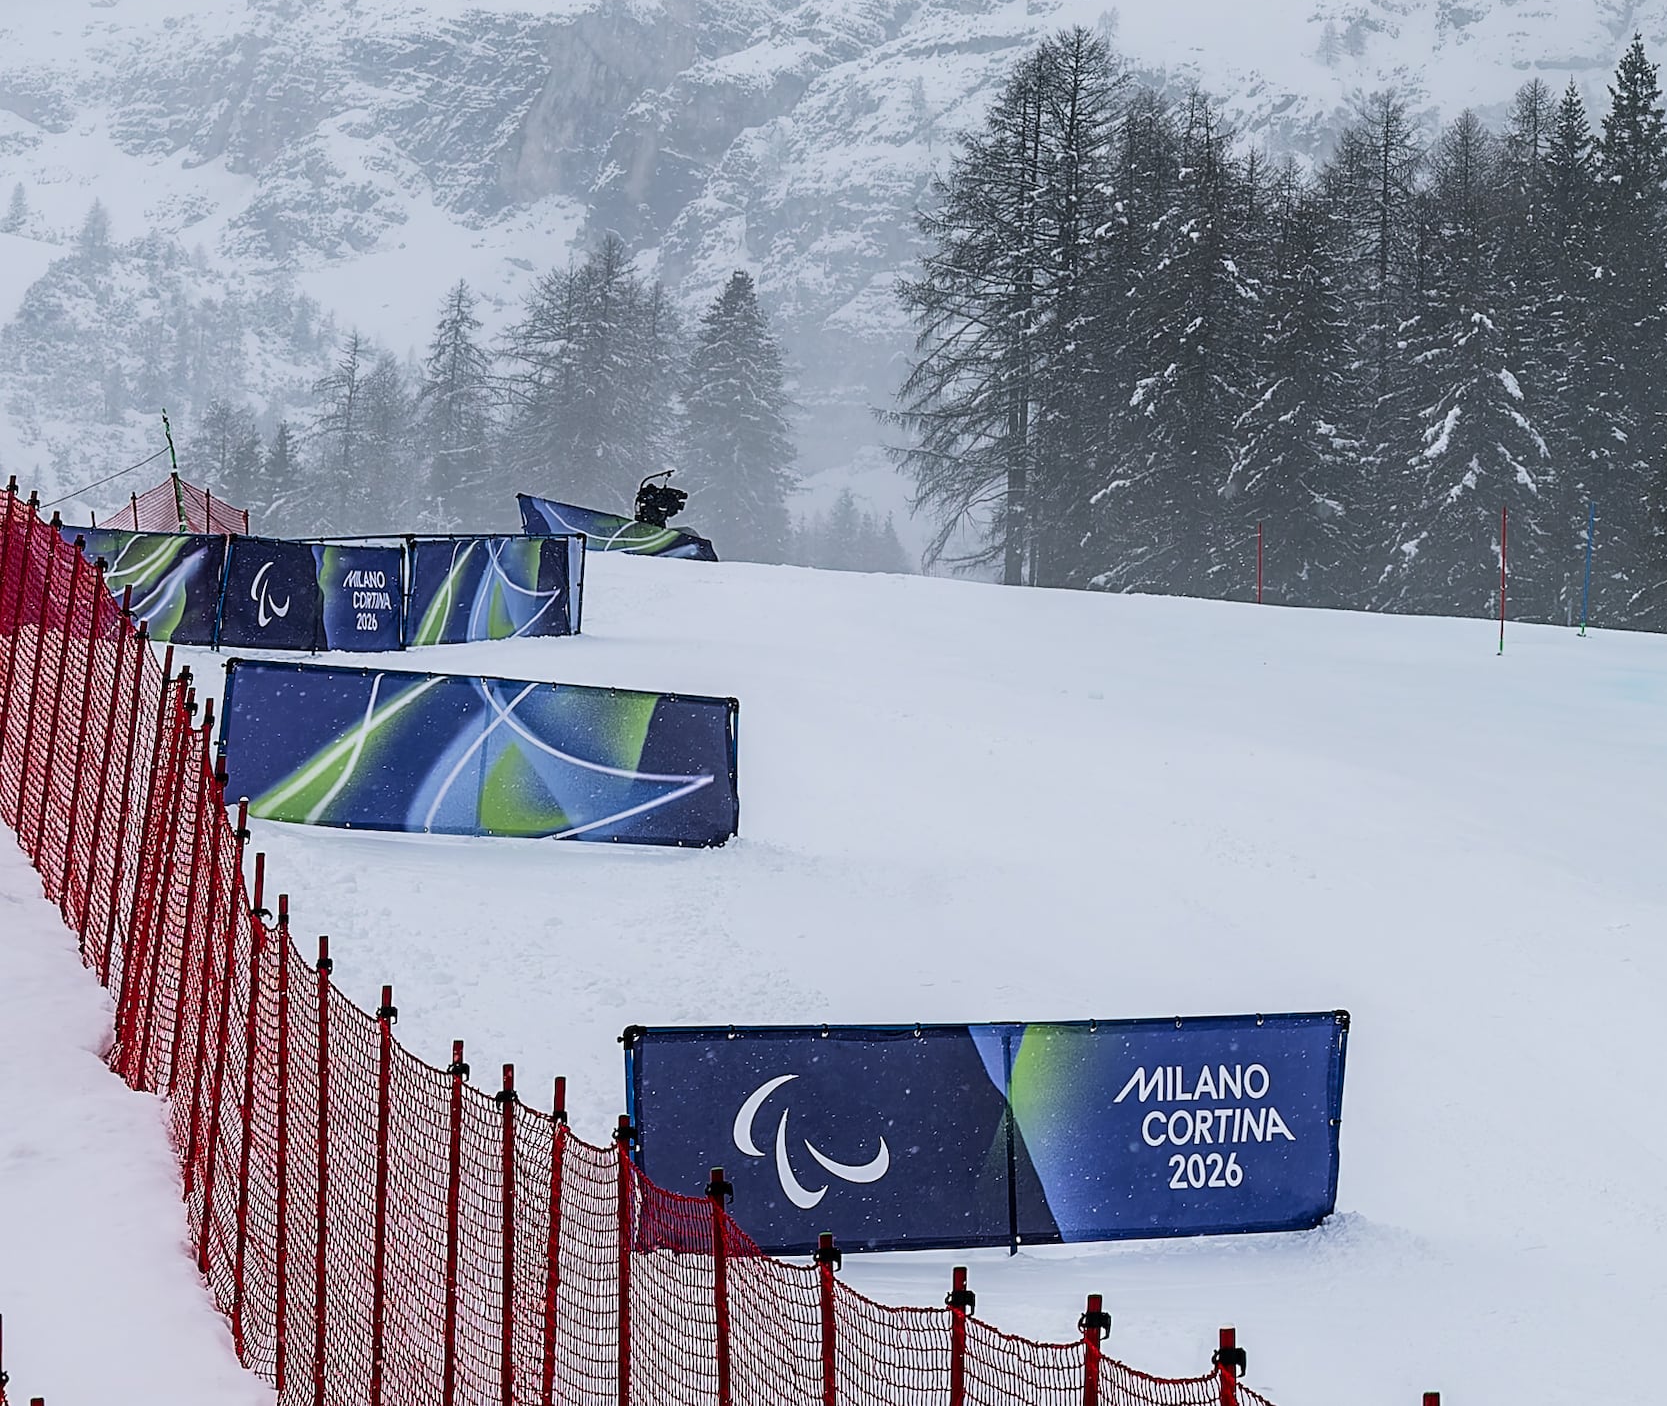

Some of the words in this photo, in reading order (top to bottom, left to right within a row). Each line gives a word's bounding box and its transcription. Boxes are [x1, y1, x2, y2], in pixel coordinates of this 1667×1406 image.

[343, 570, 385, 588] MILANO
[353, 591, 392, 610] CORTINA
[356, 612, 378, 631] 2026
[1112, 1063, 1270, 1103] MILANO
[1141, 1107, 1297, 1147] CORTINA
[1168, 1152, 1243, 1189] 2026
